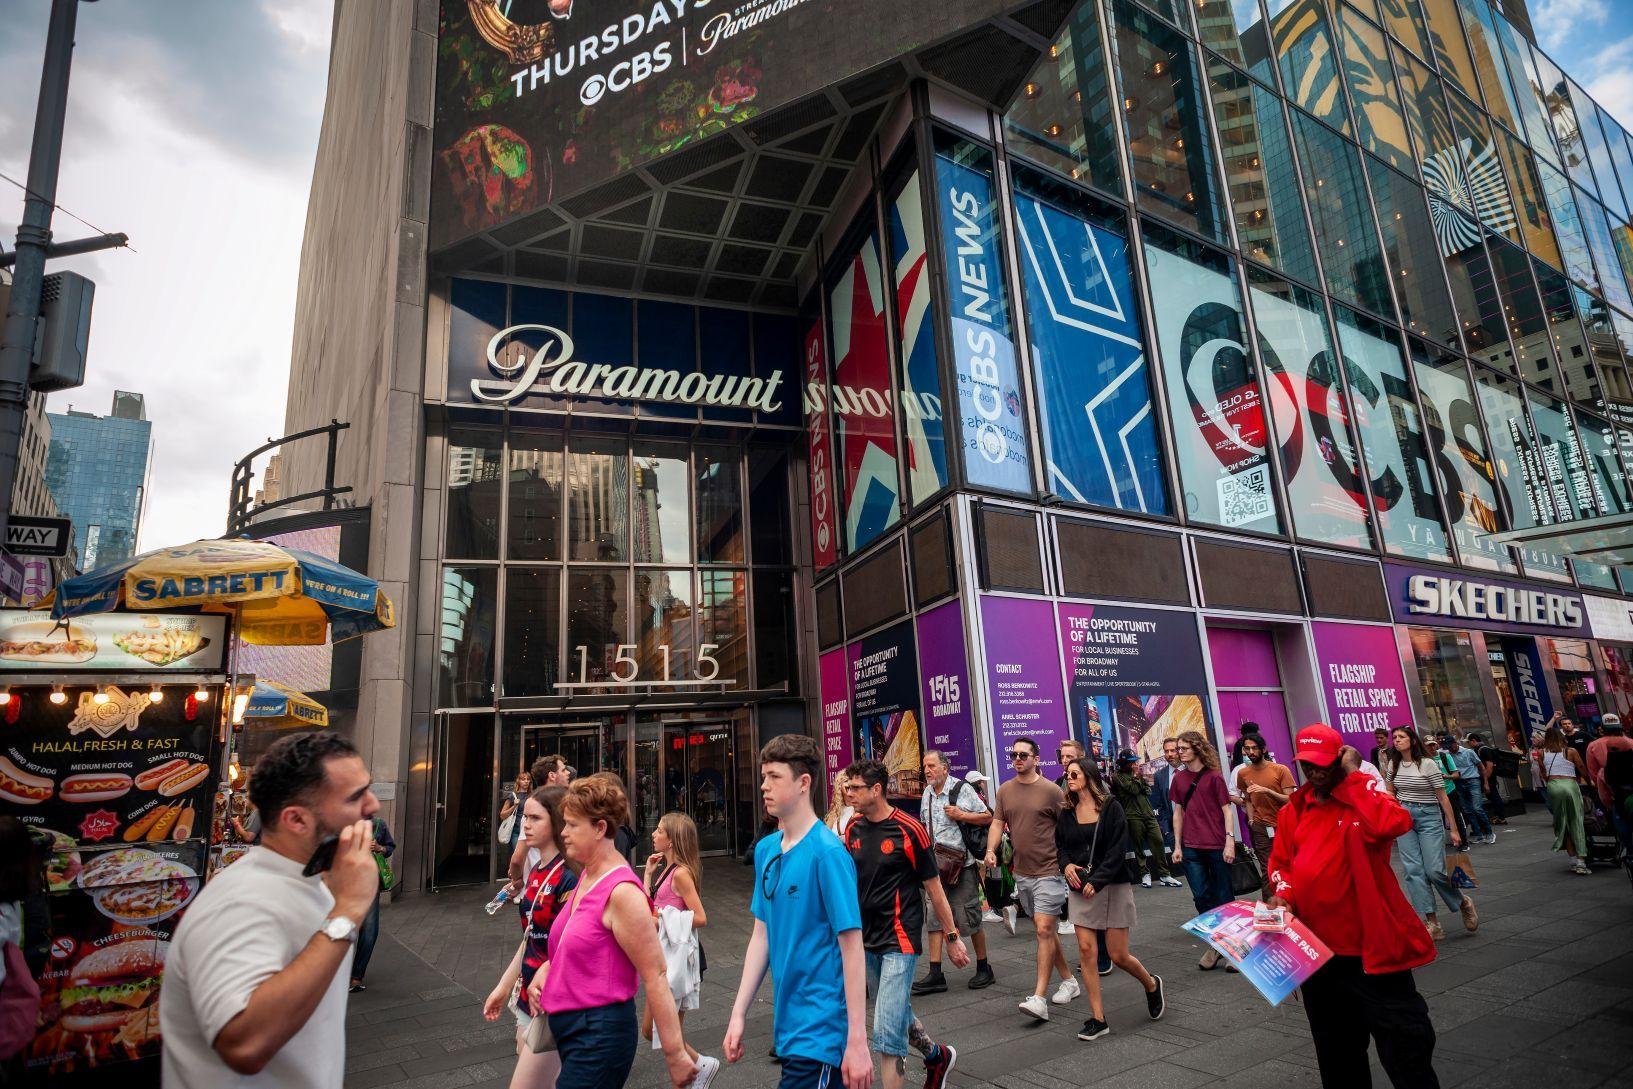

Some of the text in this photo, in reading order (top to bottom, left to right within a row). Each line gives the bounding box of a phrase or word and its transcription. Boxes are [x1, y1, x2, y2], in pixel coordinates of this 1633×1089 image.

[510, 0, 712, 98] THURSDAY
[607, 41, 672, 92] CBS
[950, 186, 993, 323] NEWS
[470, 323, 784, 413] Paramount
[967, 327, 1003, 422] CBS
[1305, 350, 1514, 533] CBS
[813, 448, 827, 520] CBS
[8, 527, 52, 544] WAY
[135, 570, 289, 601] SABRETT
[326, 585, 338, 594] ON
[344, 589, 358, 599] ROLL
[1408, 575, 1583, 628] SKECHERS
[1068, 617, 1156, 632] THE OPPORTUNITY
[1070, 630, 1138, 644] OF A LIFETIME
[854, 646, 898, 670] THE OPPORTUNITY
[1072, 646, 1084, 654] FOR
[1105, 647, 1140, 656] BUSINESSES
[576, 643, 719, 683] 1515
[996, 663, 1022, 674] CONTACT
[1086, 658, 1119, 666] BROADWAY
[854, 672, 861, 681] OF
[866, 662, 887, 678] LIFETIME
[1088, 668, 1100, 676] ALL
[1100, 668, 1108, 676] OF
[1329, 664, 1376, 684] FLAGSHIP
[928, 674, 960, 704] 1515
[1334, 688, 1398, 708] RETAIL SPACE
[826, 700, 847, 718] FLAGSHIP
[933, 700, 960, 718] BROADWAY
[826, 718, 842, 734] RETAIL
[1339, 712, 1391, 734] FOR LEASE
[131, 738, 144, 750] &
[148, 738, 180, 750] FAST
[828, 736, 842, 752] SPACE
[70, 762, 101, 771] MEDIUM
[118, 762, 134, 770] DOG
[148, 752, 172, 764] SMALL
[188, 752, 205, 762] DOG
[828, 754, 838, 768] FOR
[26, 762, 40, 774] HOT
[40, 766, 57, 776] DOG
[127, 799, 158, 820] CORN DOG
[22, 816, 45, 824] GYRO
[88, 818, 114, 829] حلال
[94, 930, 170, 948] CHEESEBURGER
[1284, 927, 1320, 961] ONE PASS
